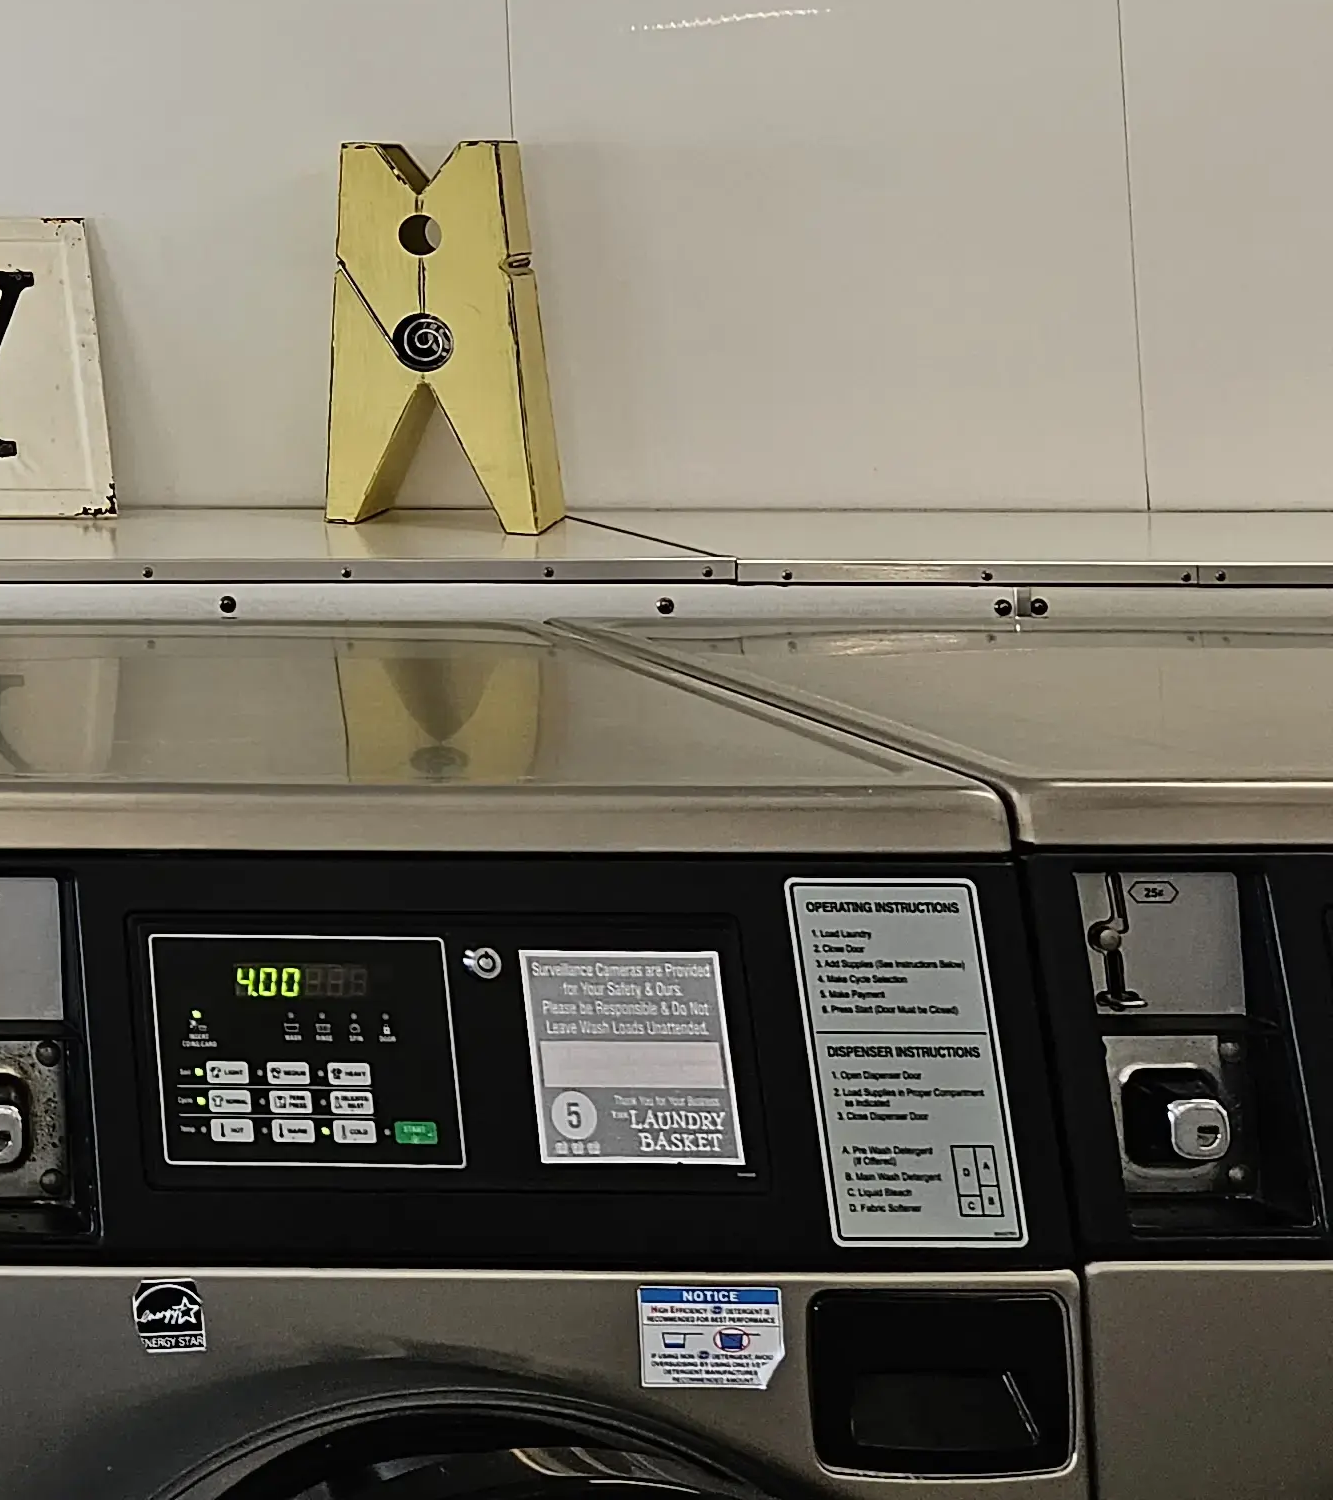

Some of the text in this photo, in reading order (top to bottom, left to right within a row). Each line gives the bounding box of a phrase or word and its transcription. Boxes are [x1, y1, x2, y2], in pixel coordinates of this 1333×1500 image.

[806, 902, 959, 913] OPERATING INSTRUCTIONS
[595, 963, 642, 976] Cameras
[645, 965, 662, 976] are
[665, 964, 711, 978] Provided
[236, 967, 300, 997] 4.00
[827, 1046, 981, 1058] DISPENSER INSTRUCTIONS
[566, 1102, 581, 1129] 5
[629, 1110, 725, 1129] LAUNDRY
[640, 1132, 723, 1151] BASKET
[683, 1291, 739, 1302] NOTICE
[178, 1336, 204, 1346] STAR
